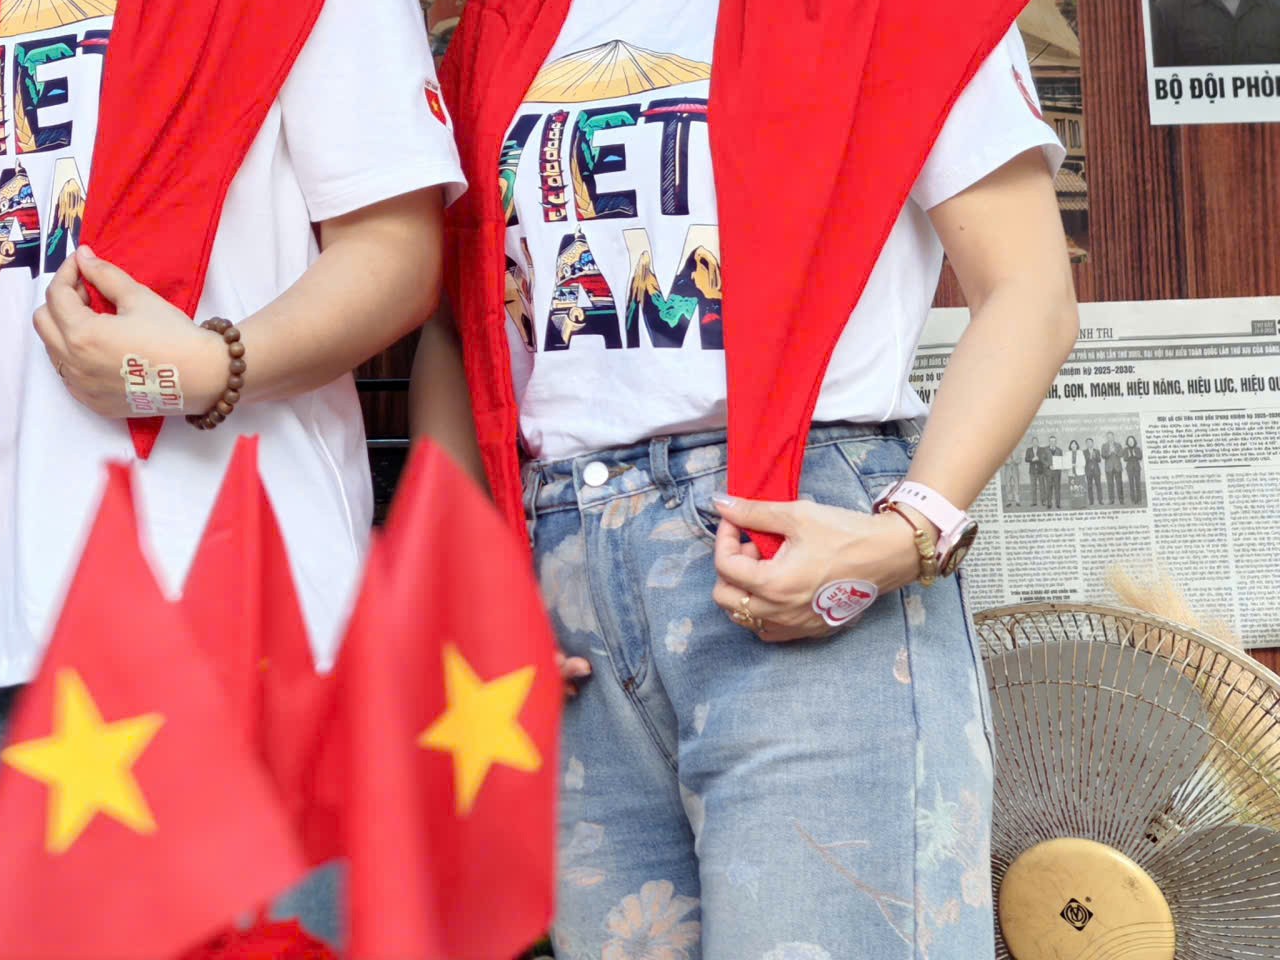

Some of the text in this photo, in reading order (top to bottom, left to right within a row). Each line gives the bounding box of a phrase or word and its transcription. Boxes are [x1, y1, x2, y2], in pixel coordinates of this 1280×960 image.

[1154, 73, 1183, 105] BỘ
[1189, 73, 1225, 104] ĐỘI
[916, 386, 931, 404] ÂY
[1064, 383, 1087, 401] GỌN,
[1090, 381, 1124, 400] MẠNH,
[1127, 377, 1150, 400] HIỆU
[1187, 375, 1211, 398] HIỆU
[1241, 373, 1265, 396] HIỆU
[1270, 376, 1280, 392] QU
